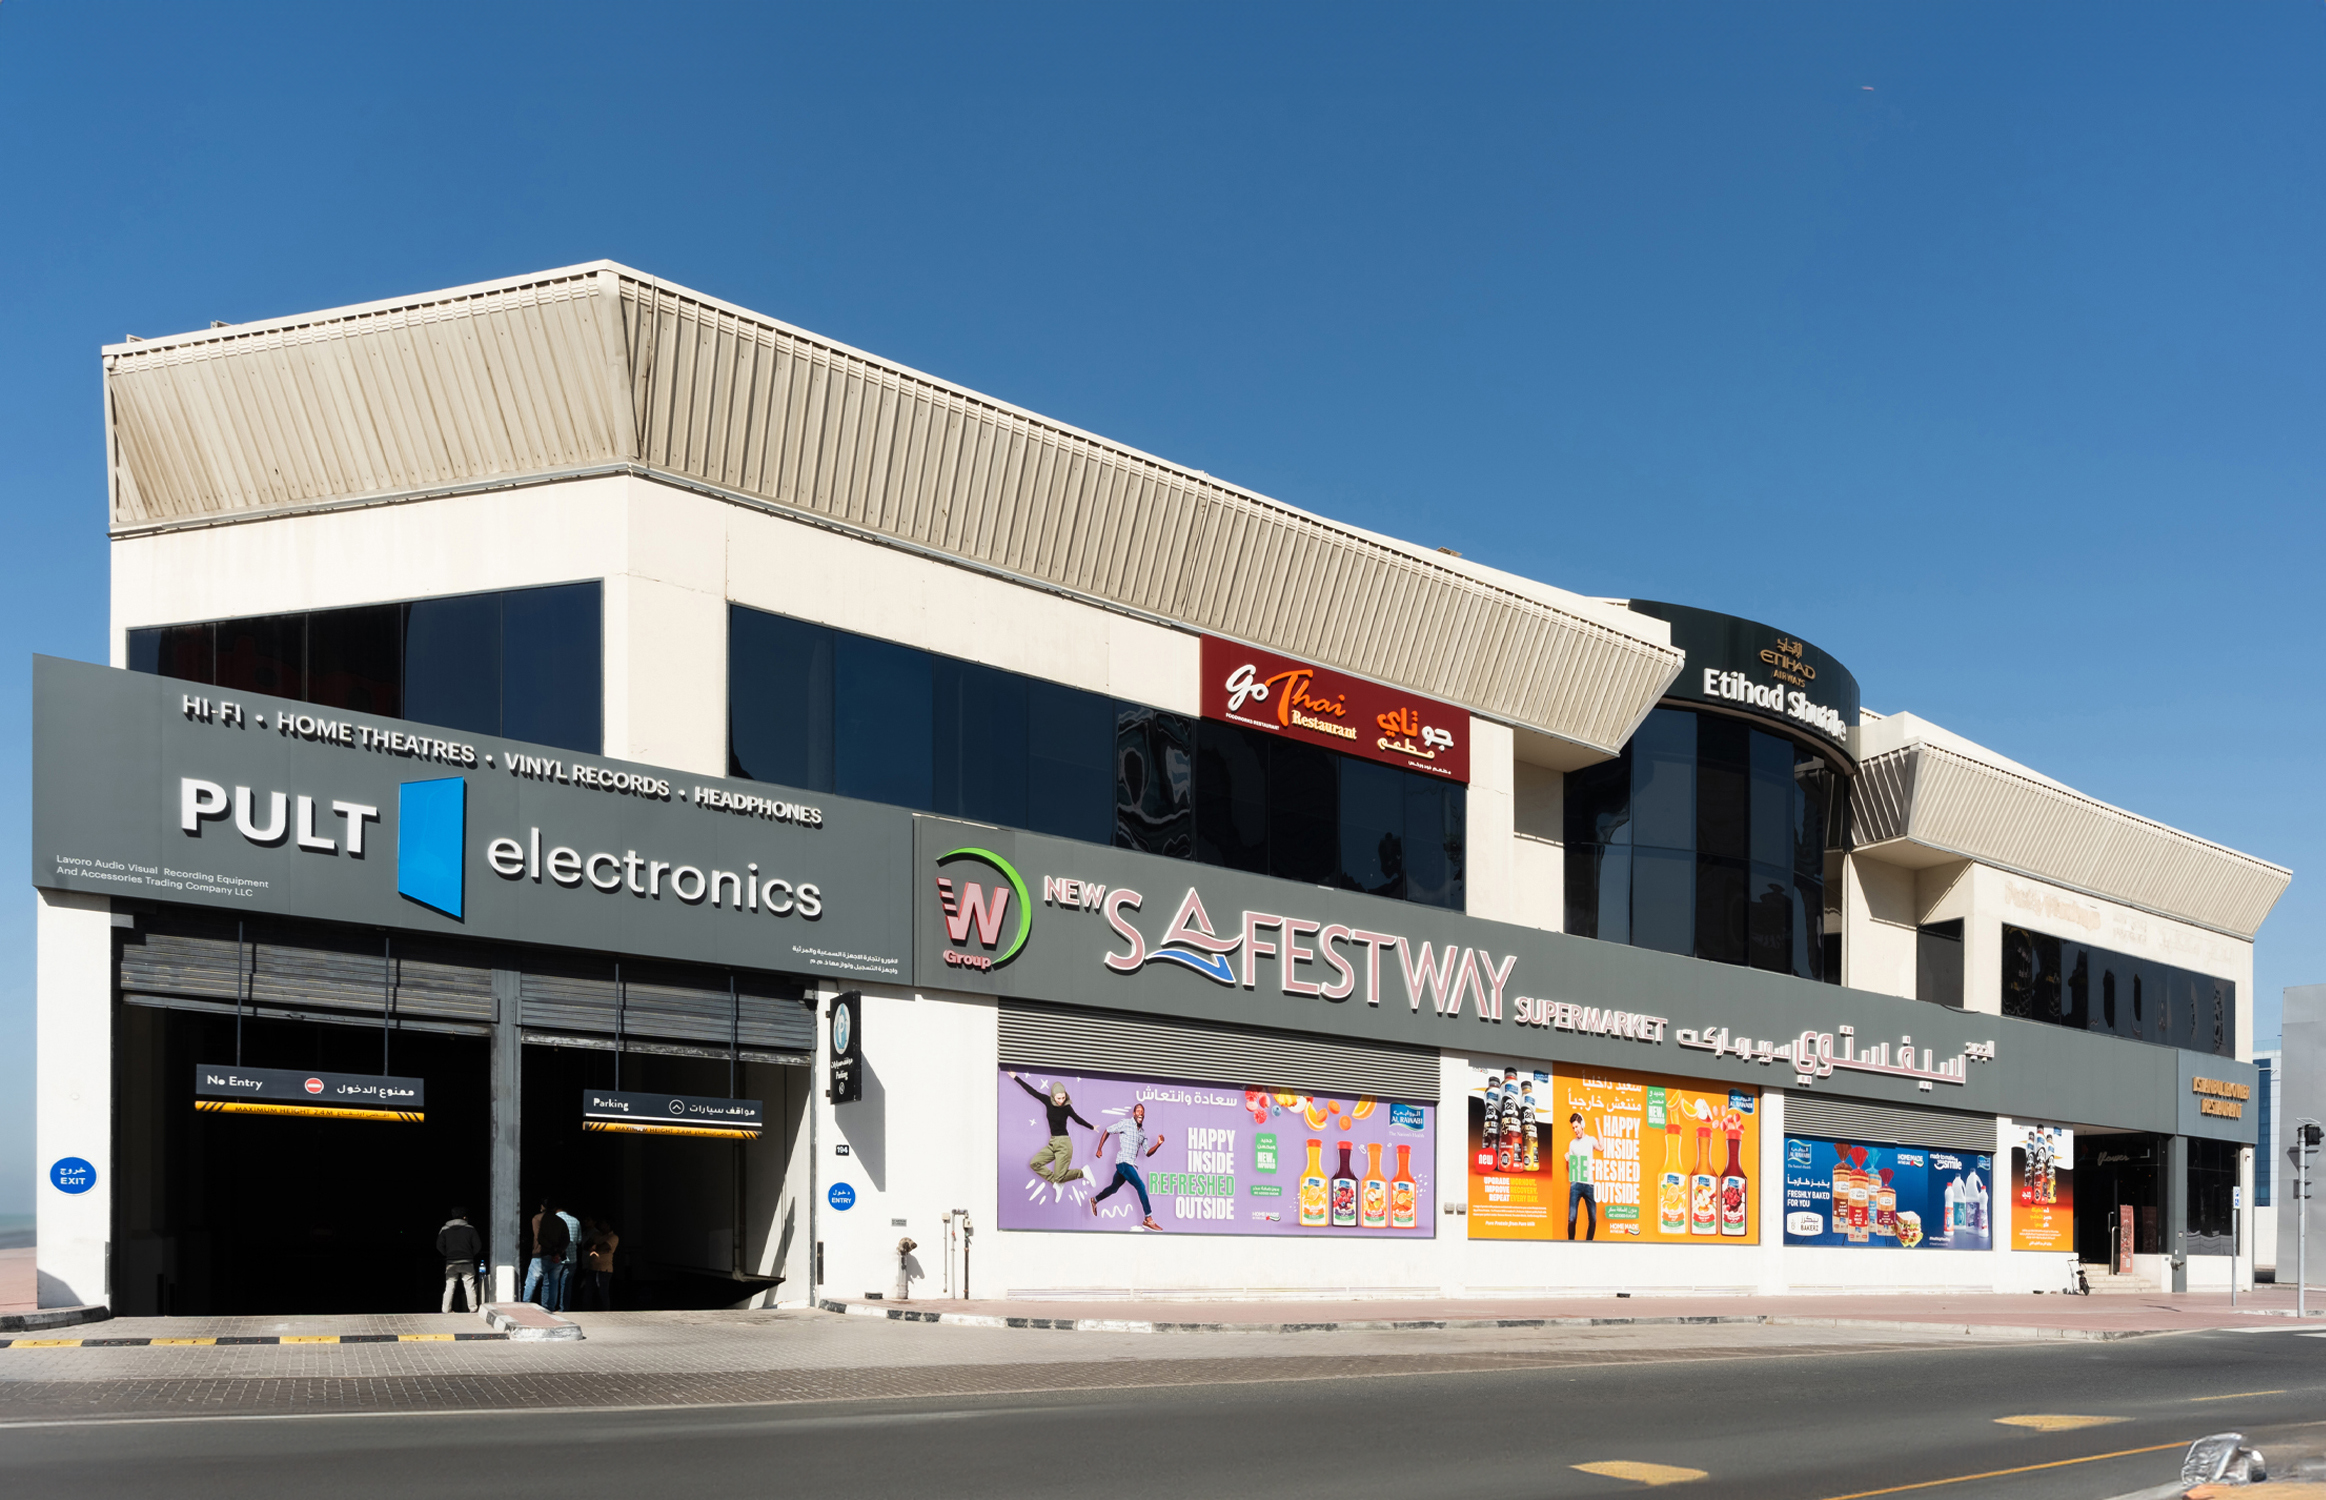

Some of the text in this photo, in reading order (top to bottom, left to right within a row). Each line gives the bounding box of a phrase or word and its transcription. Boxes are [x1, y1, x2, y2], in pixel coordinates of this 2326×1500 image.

[1760, 650, 1816, 680] ETIHAD
[1774, 670, 1805, 688] AIRWAYS
[1264, 669, 1346, 726] Thai
[1704, 668, 1847, 742] Etihad Shuttle
[1291, 709, 1357, 739] Restaurant
[1377, 707, 1454, 751] جو تاي
[183, 694, 822, 824] HI-FI HOME THEATRES VINYL RECORDS HEADPHONES
[1377, 737, 1435, 759] مطعم
[180, 777, 377, 854] PULT
[56, 855, 269, 888] Lavoro Audio Visual Recording Equipment
[56, 867, 253, 897] And Accessories Trading Company LLC
[487, 827, 822, 916] electronics
[943, 950, 992, 969] Group
[1044, 875, 1106, 909] NEW
[1514, 996, 1668, 1044] SUPERMARKET
[1676, 1027, 1791, 1064] سوبرماركت
[207, 1075, 262, 1091] No Entry
[337, 1084, 415, 1098] ممنوع الدخول
[594, 1098, 629, 1112] Parking
[1136, 1086, 1238, 1107] سعادة وانتعاش
[1607, 1096, 1641, 1112] منتعش
[689, 1104, 724, 1116] سيارات
[1603, 1115, 1641, 1138] HAPPY
[1188, 1127, 1235, 1151] HAPPY
[1603, 1137, 1640, 1160] INSIDE
[60, 1167, 86, 1175] خروج
[1188, 1150, 1234, 1174] INSIDE
[1478, 1154, 1494, 1165] new
[60, 1177, 86, 1185] EXIT
[1149, 1172, 1235, 1196] REFRESHED
[1484, 1176, 1510, 1185] UPGRADE
[1485, 1185, 1510, 1193] IMPROVE
[1489, 1193, 1510, 1202] REPEAT
[1593, 1181, 1640, 1204] OUTSIDE
[1787, 1190, 1830, 1200] FRESHLY BAKED
[1799, 1200, 1810, 1208] YOU
[1176, 1196, 1234, 1220] OUTSIDE
